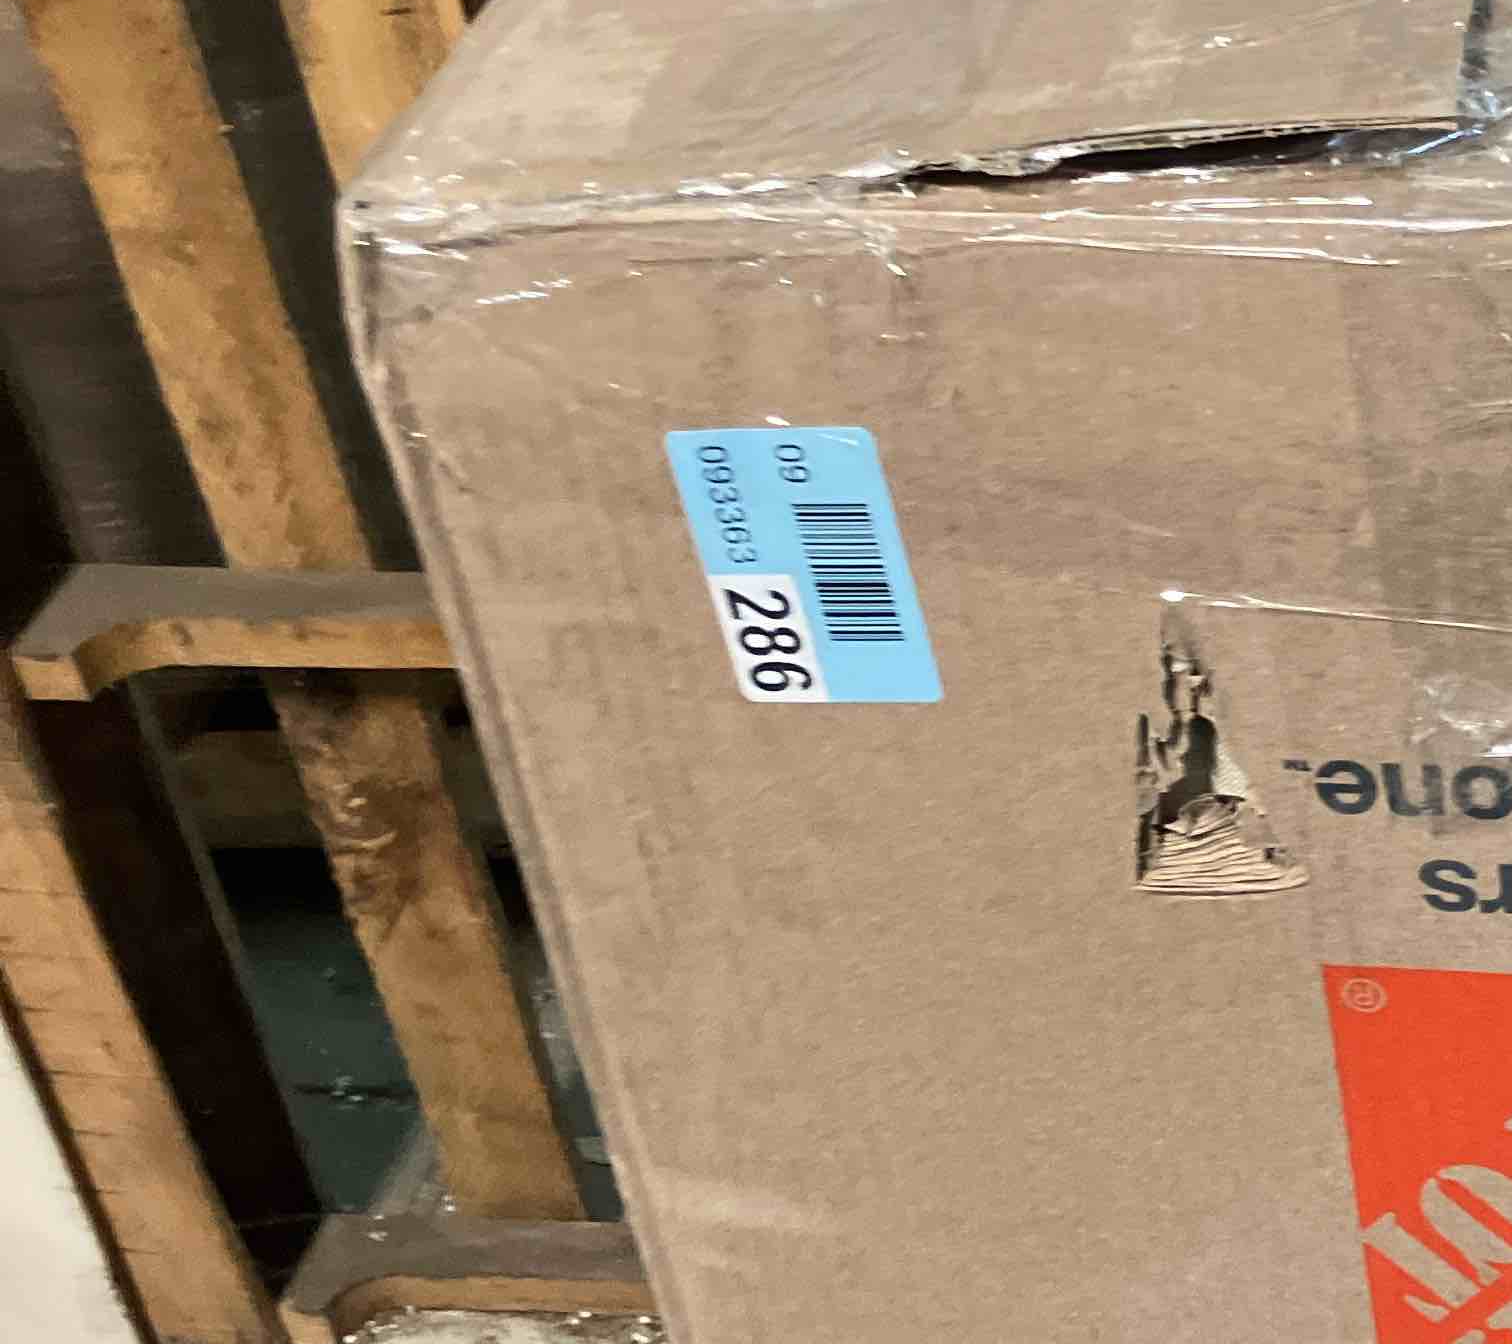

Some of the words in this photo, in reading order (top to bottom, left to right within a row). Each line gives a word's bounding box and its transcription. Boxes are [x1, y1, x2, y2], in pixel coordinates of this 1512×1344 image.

[696, 444, 761, 565] 093363
[774, 442, 814, 485] 09
[721, 587, 813, 693] 286
